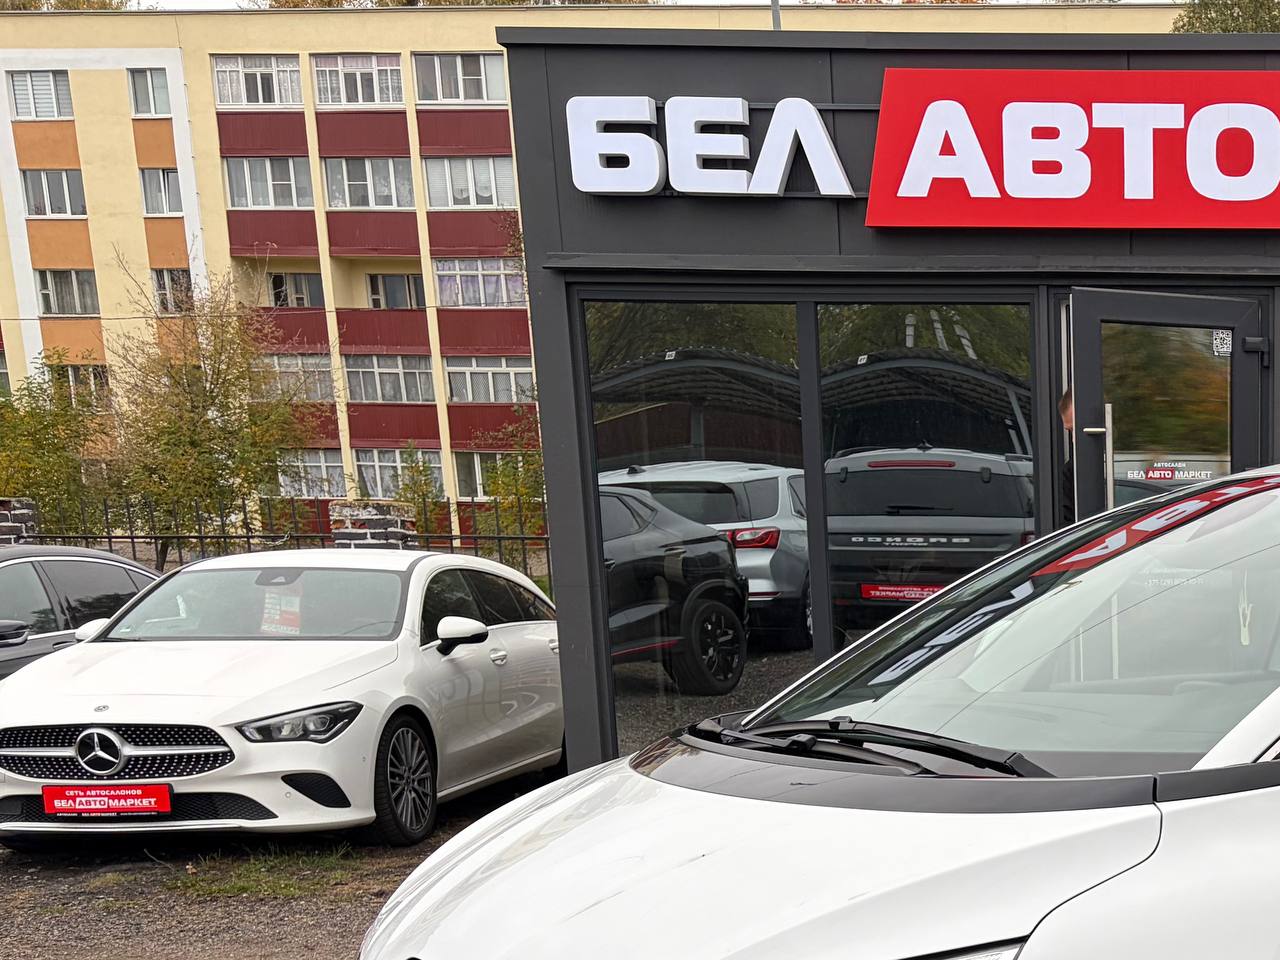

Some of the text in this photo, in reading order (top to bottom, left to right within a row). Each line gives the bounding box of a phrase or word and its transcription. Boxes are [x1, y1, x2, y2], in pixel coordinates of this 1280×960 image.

[565, 95, 856, 198] БЕЛ
[1127, 470, 1212, 479] БЕЛ АВТО МАРКЕТ
[54, 798, 157, 807] БЕЛ АВТО МАРКЕТ
